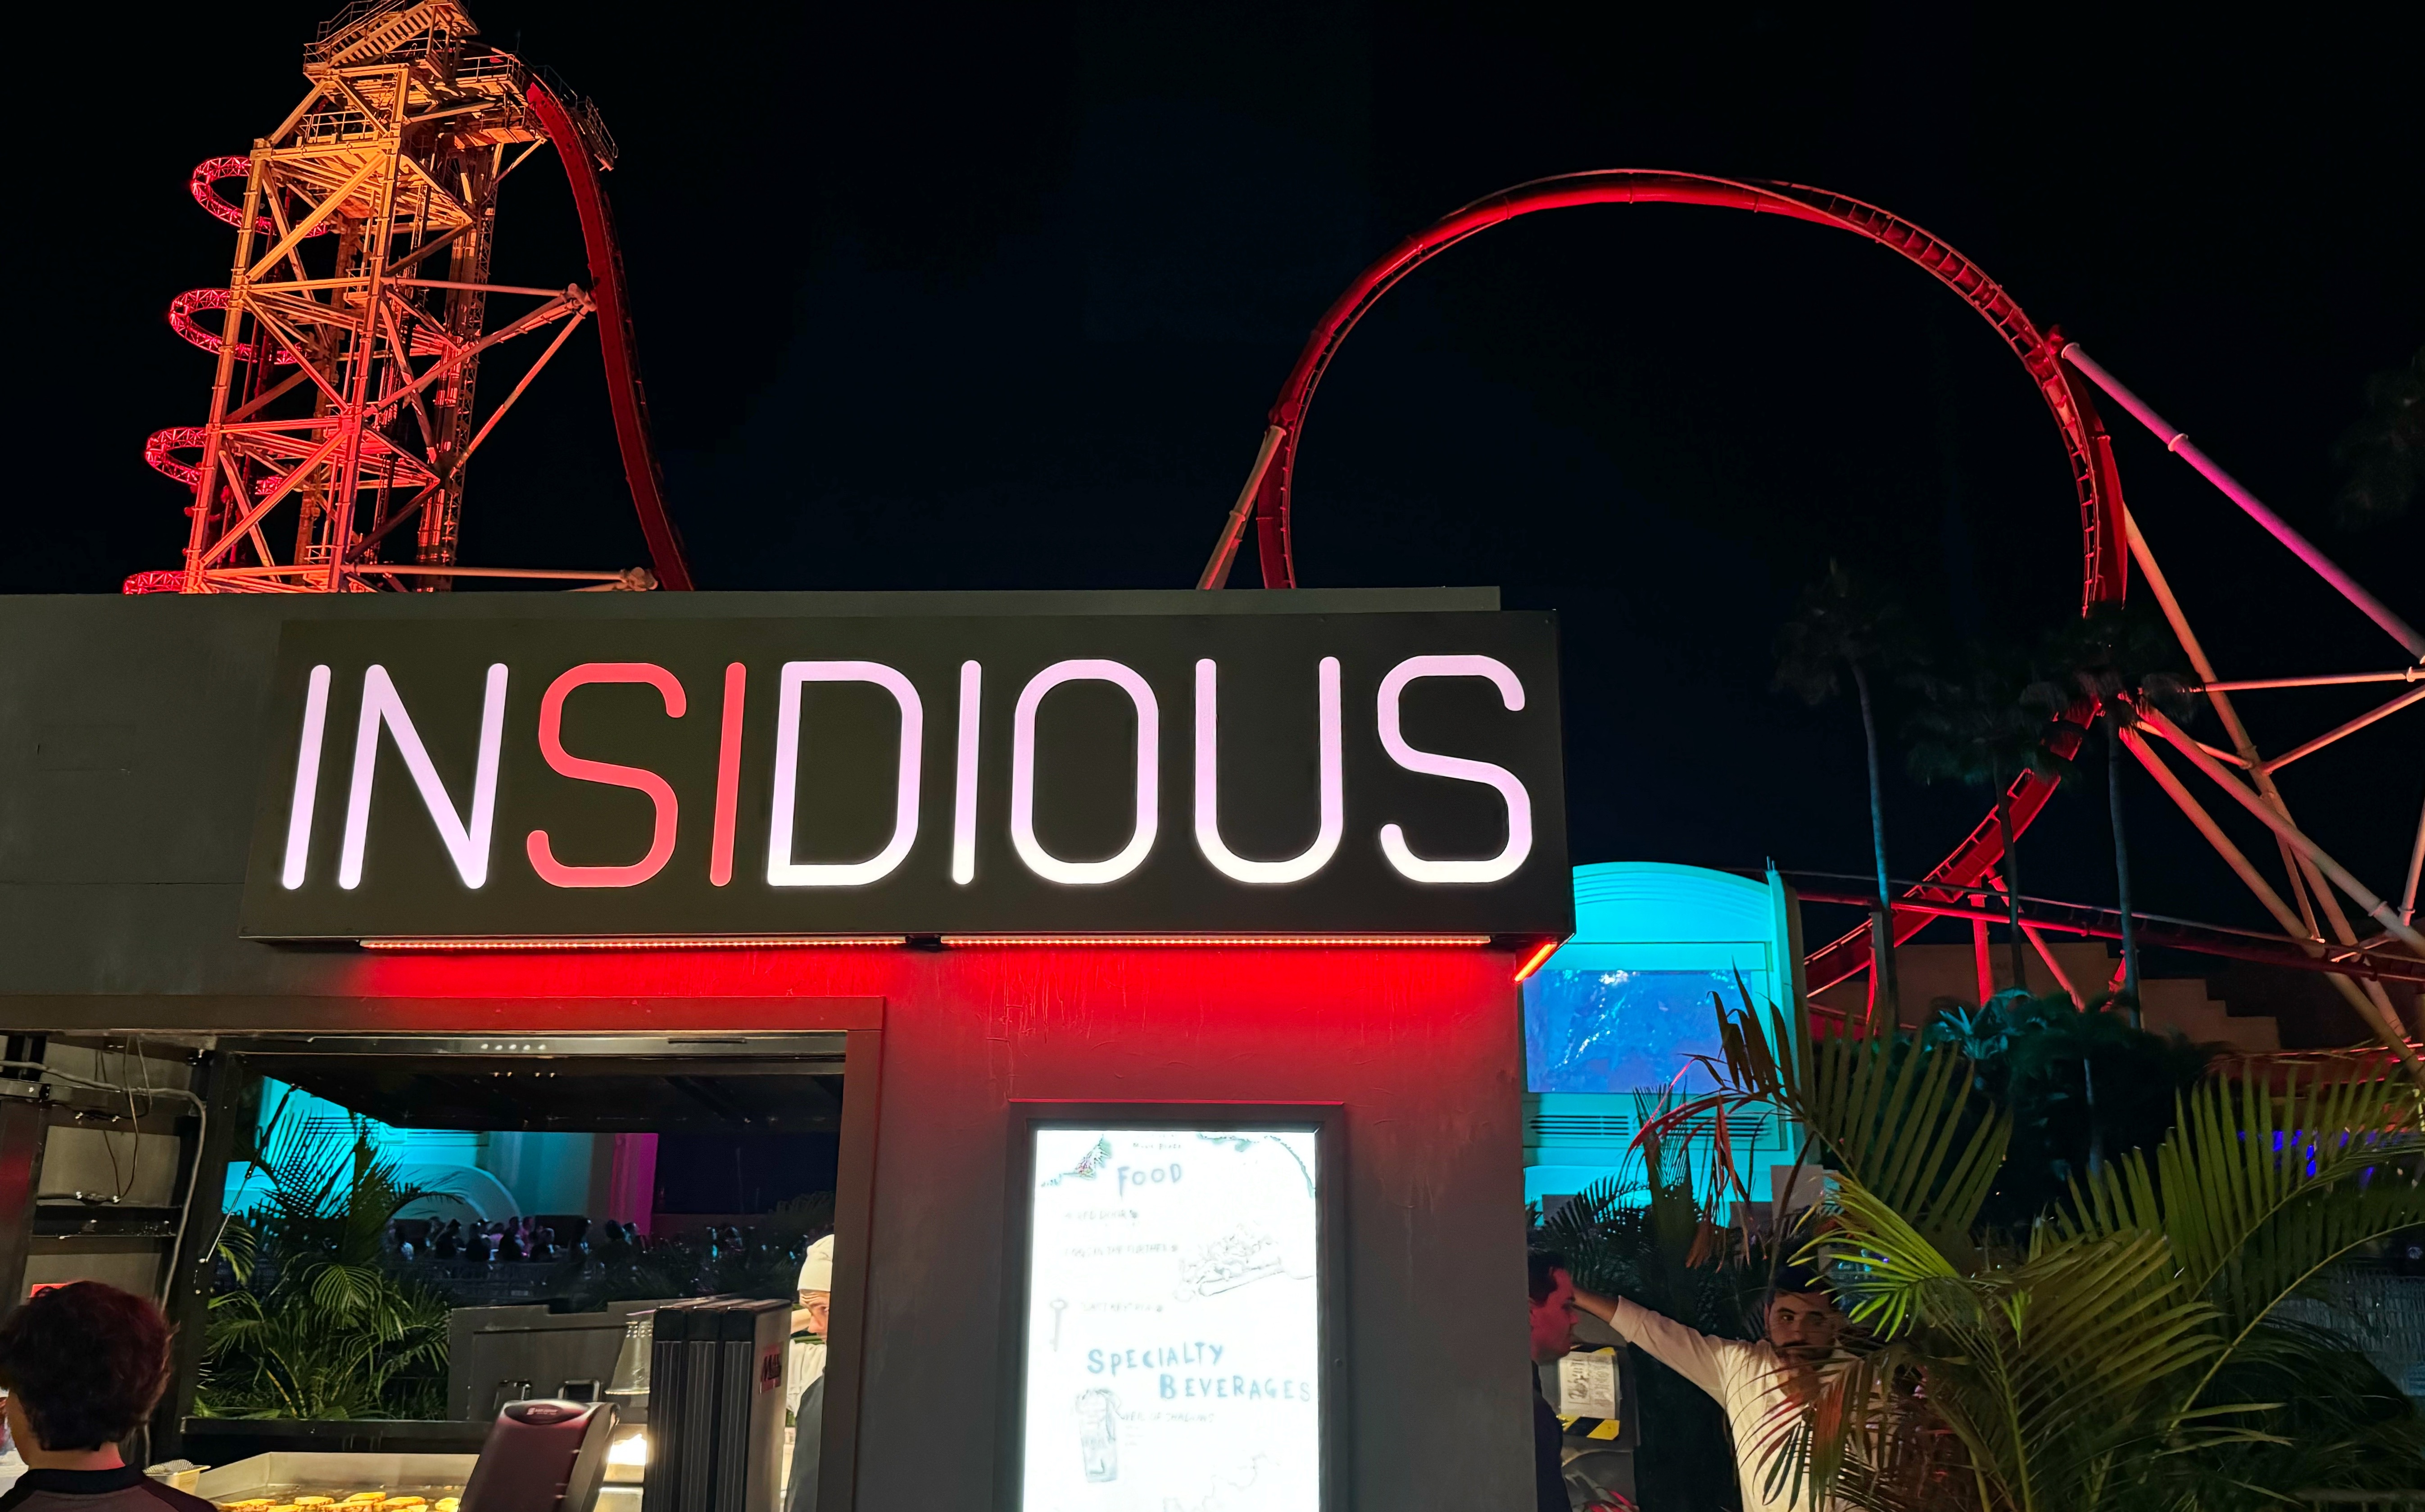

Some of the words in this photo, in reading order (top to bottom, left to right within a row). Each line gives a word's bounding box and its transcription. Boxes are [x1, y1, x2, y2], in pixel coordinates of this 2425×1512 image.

[282, 655, 1532, 889] INSIDIOUS
[1118, 1163, 1182, 1199] FOOD
[1087, 1342, 1224, 1376] SPECIALTY
[1160, 1374, 1311, 1402] BEVERAGES
